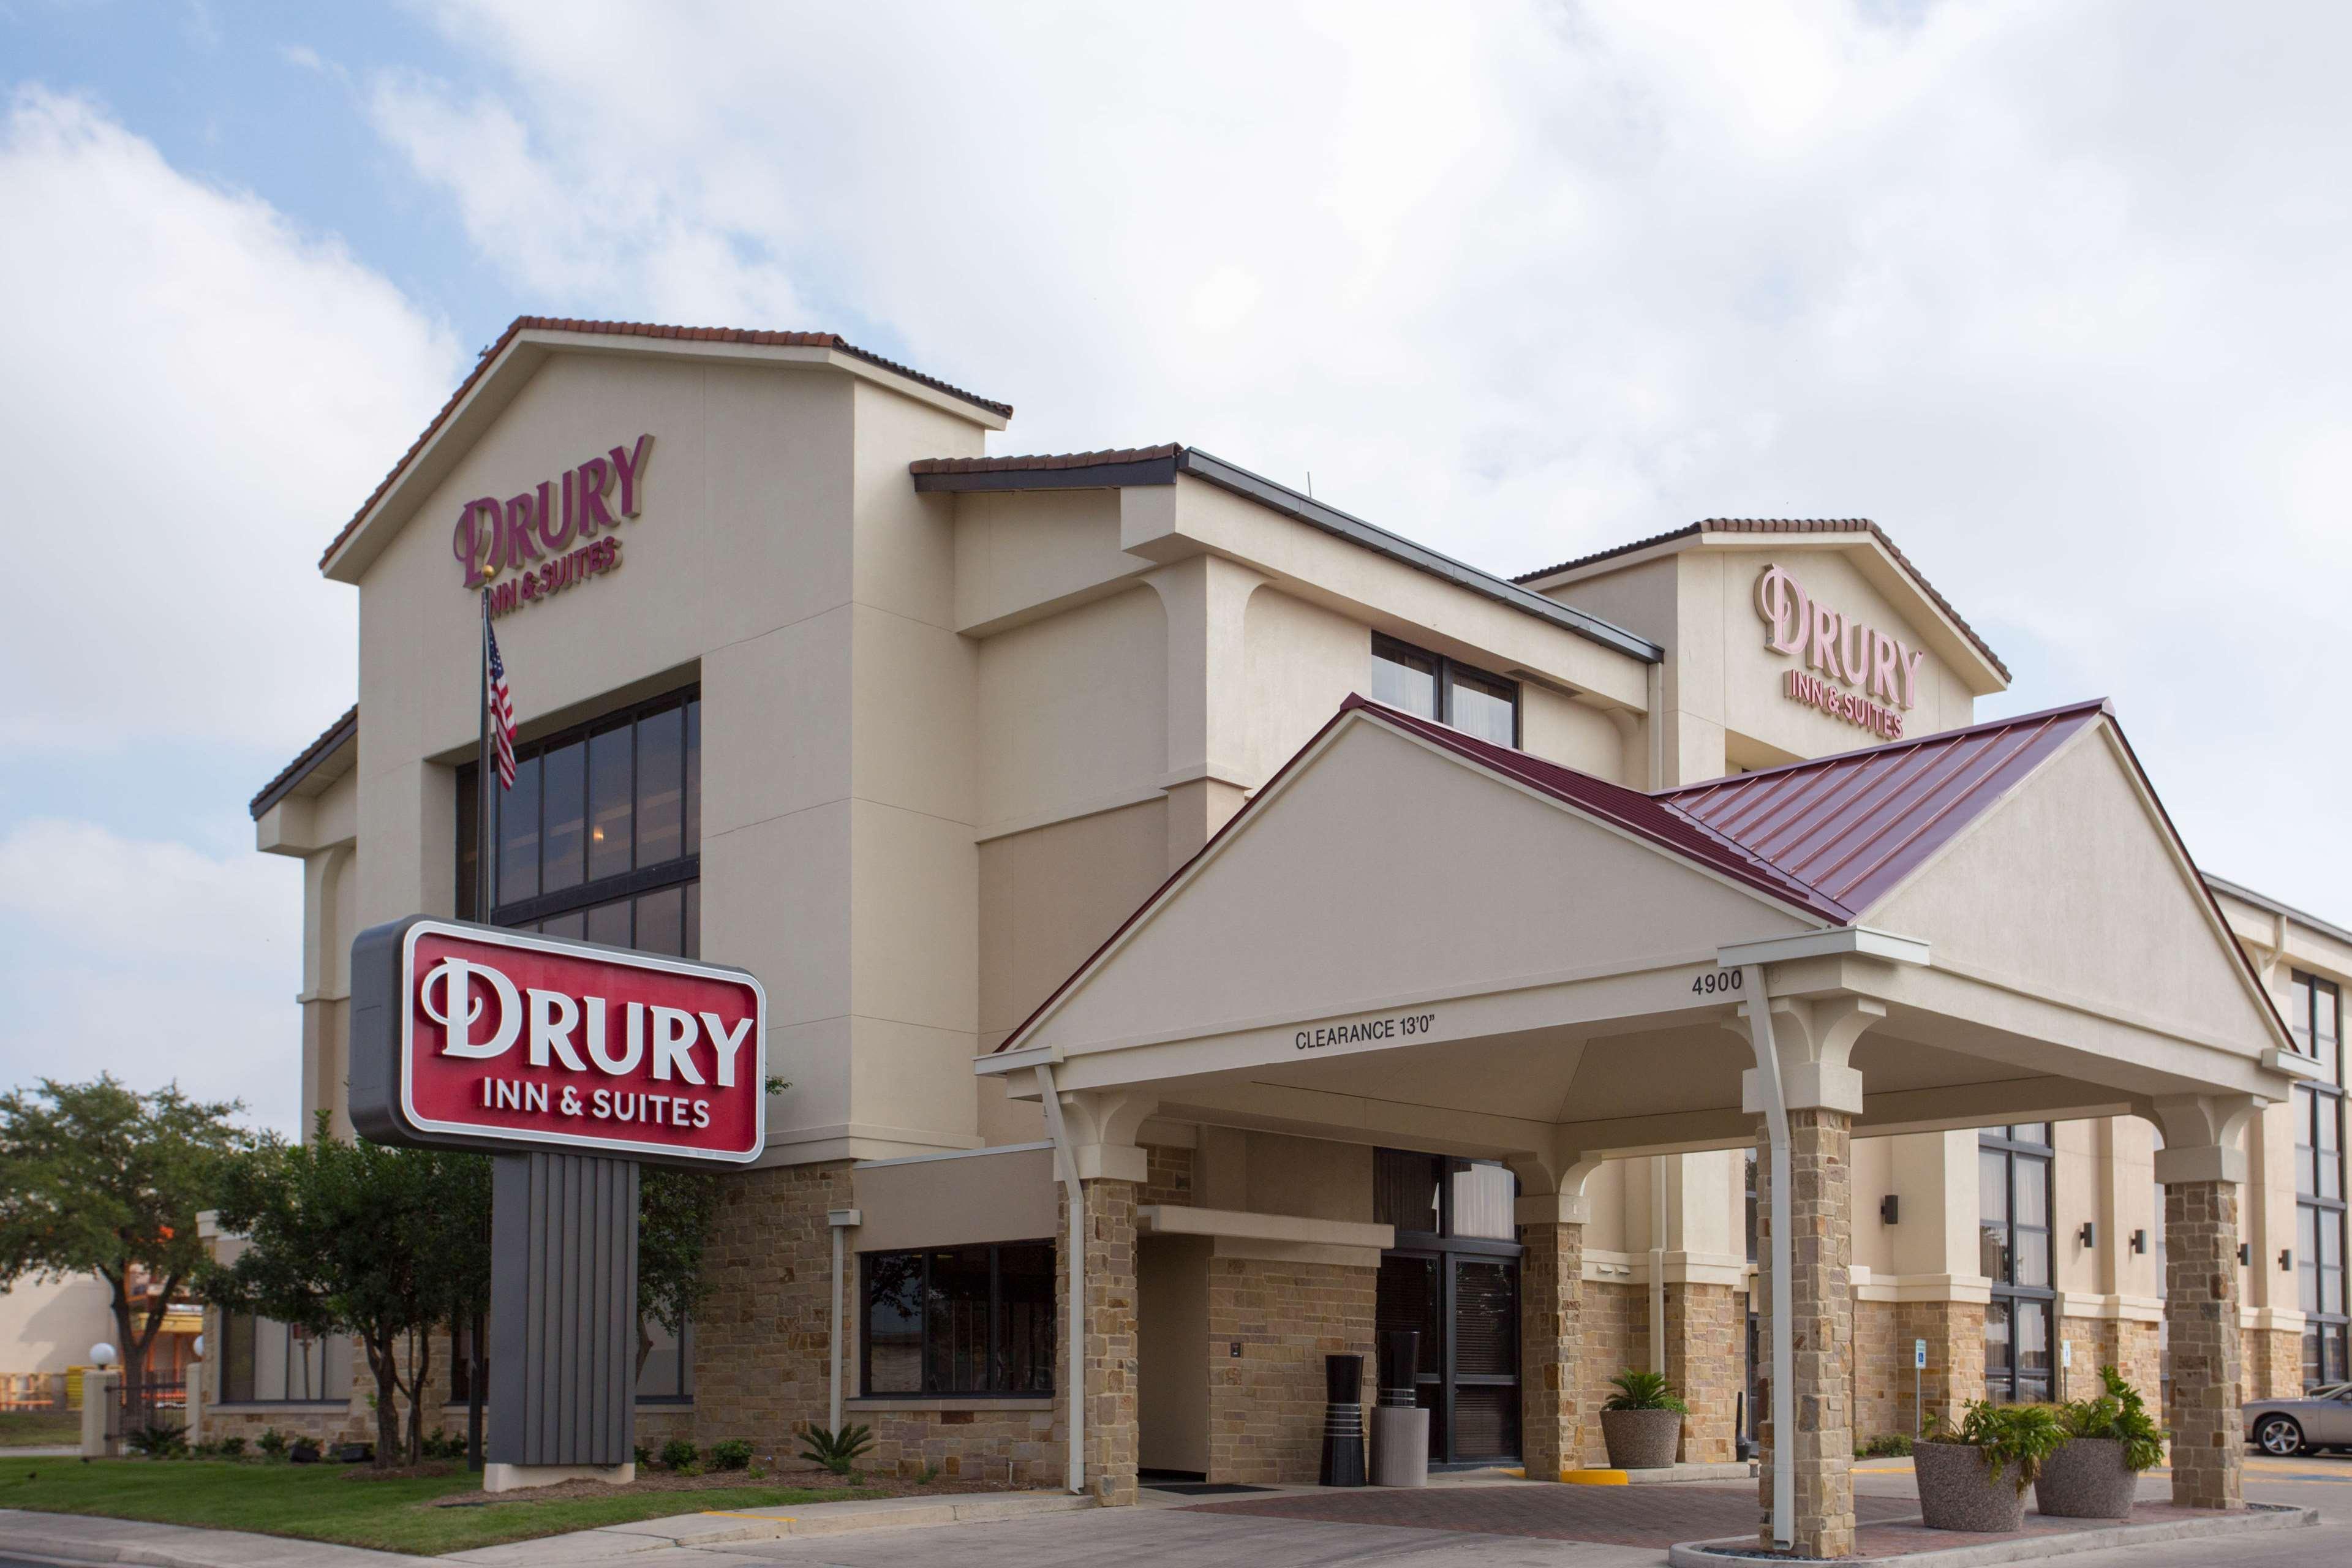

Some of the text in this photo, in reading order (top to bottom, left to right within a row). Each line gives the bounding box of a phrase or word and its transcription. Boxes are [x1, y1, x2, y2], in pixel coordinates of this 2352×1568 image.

[453, 434, 654, 588] DRURY
[521, 571, 538, 600] &
[539, 536, 619, 593] SUITES
[1755, 563, 1924, 709] DRURY
[1791, 669, 1903, 739] INN & SUITES
[1692, 970, 1741, 995] 4900
[421, 957, 754, 1088] DRURY
[1295, 1019, 1395, 1049] CLEARANCE
[484, 1077, 710, 1128] INN & SUITES
